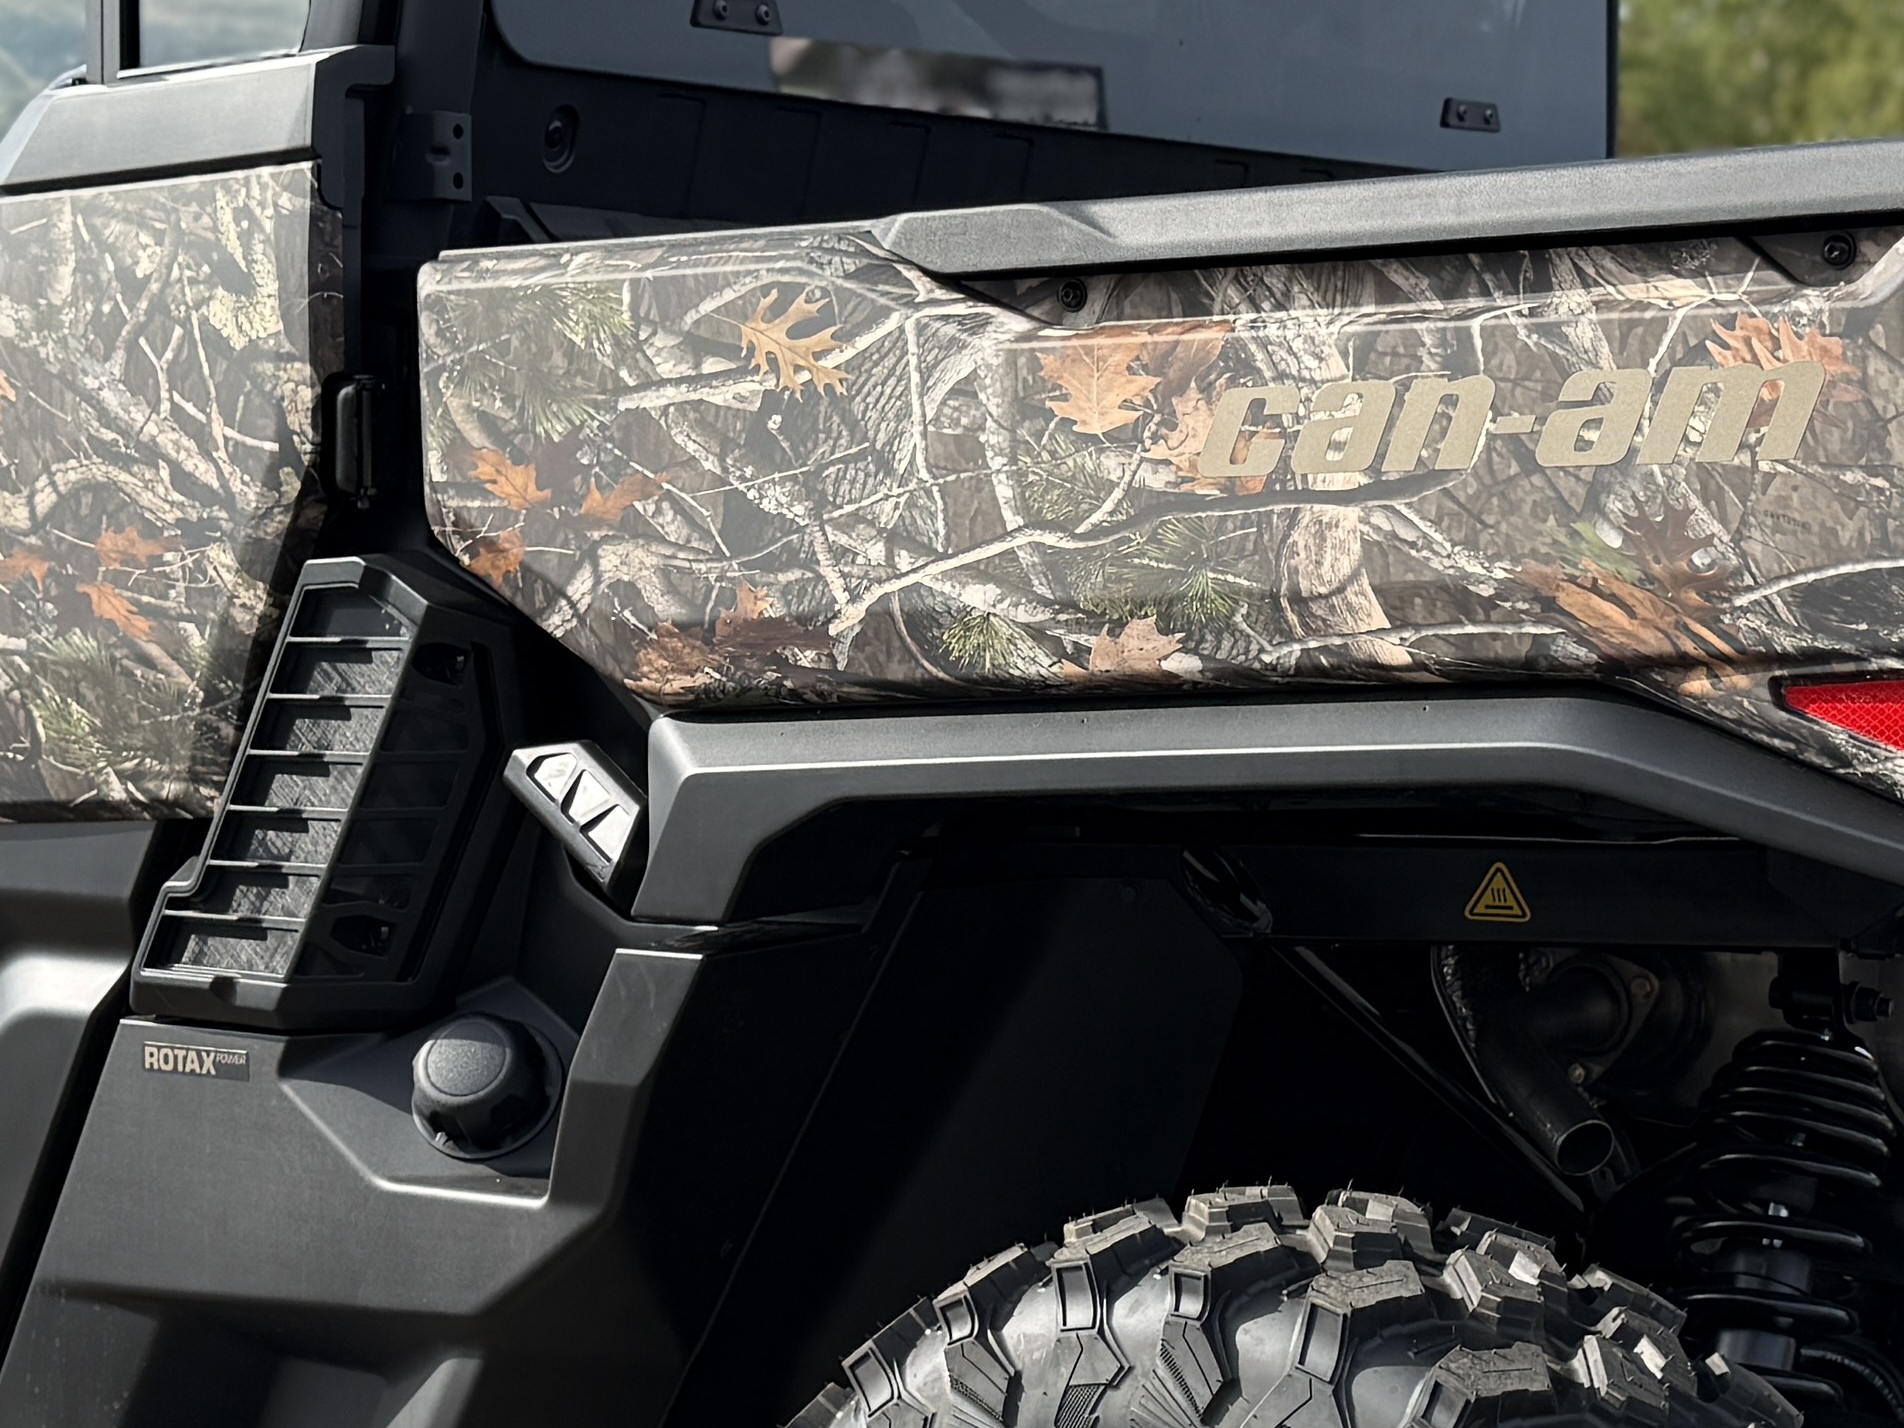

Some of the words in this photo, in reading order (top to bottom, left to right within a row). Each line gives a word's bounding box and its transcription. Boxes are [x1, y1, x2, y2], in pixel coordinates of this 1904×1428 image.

[1198, 361, 1826, 477] can-am
[144, 1045, 216, 1075] ROTAX
[215, 1053, 247, 1065] POWER
